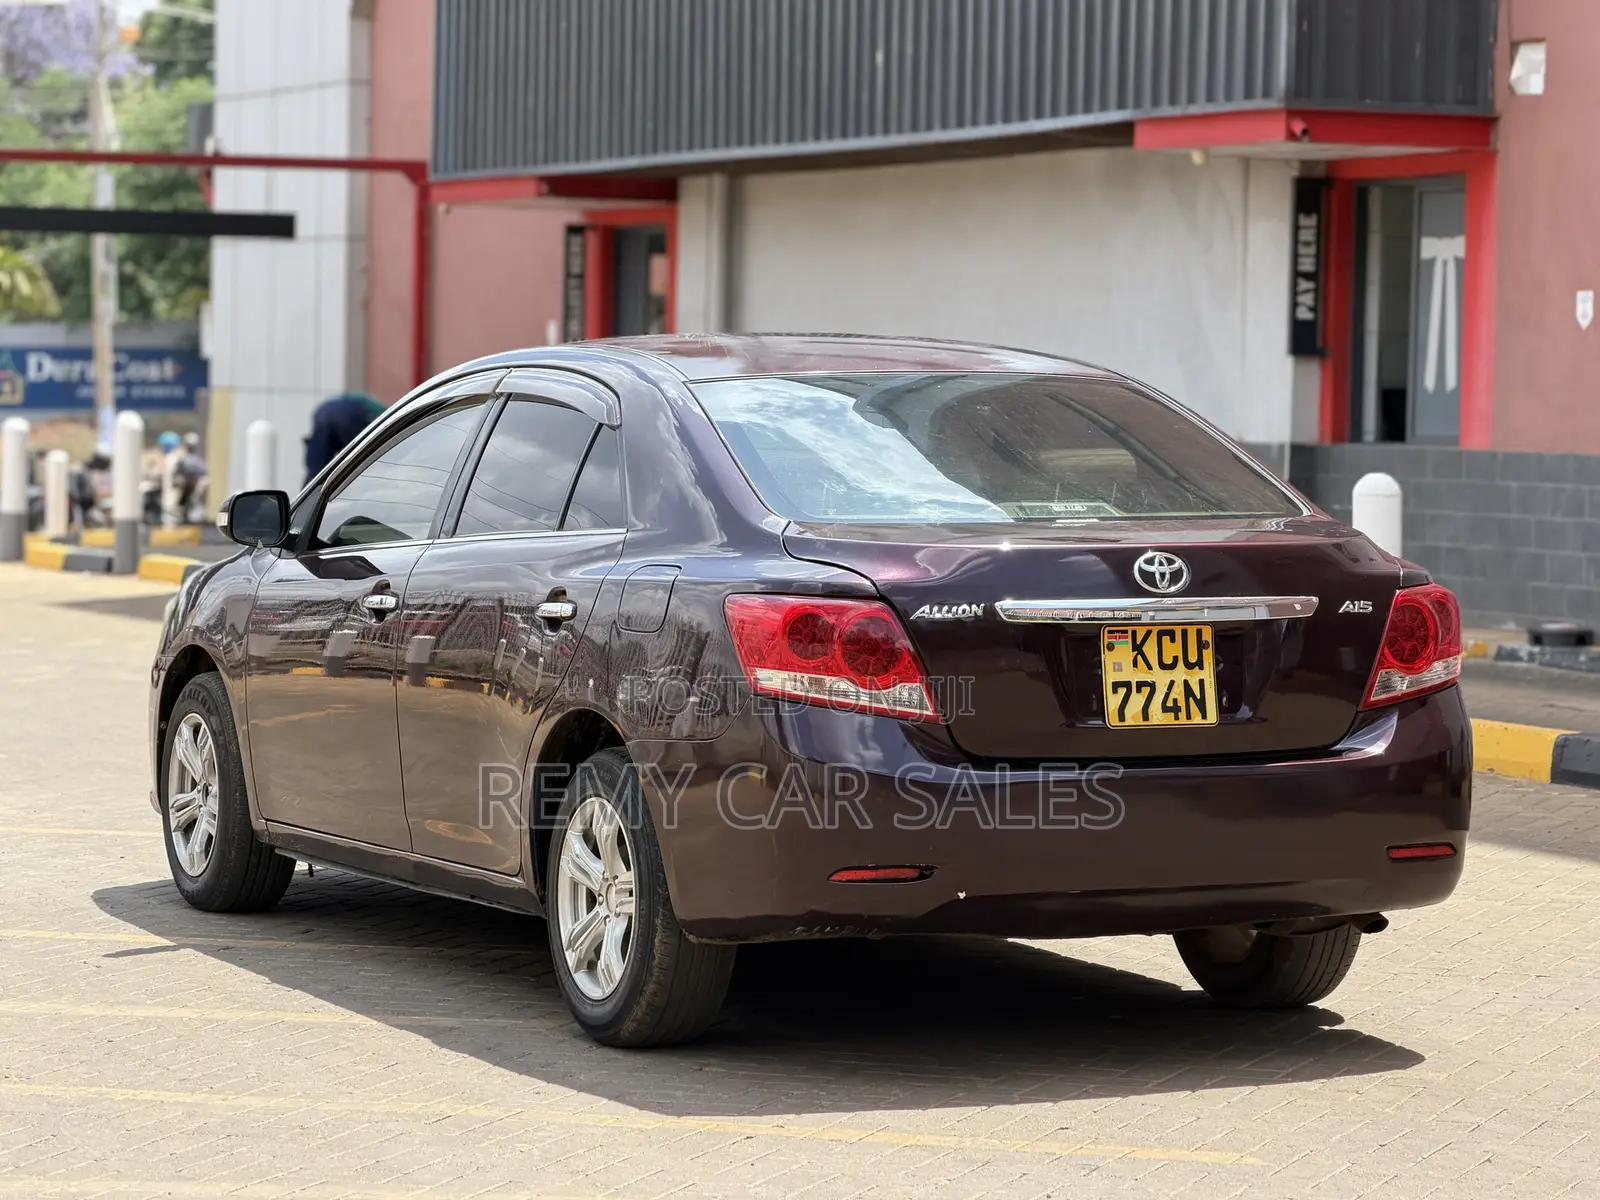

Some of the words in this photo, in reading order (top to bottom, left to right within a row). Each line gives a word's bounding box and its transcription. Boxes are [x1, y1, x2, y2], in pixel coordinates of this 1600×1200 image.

[1296, 212, 1319, 273] HERE
[1295, 277, 1317, 321] PAY
[909, 603, 985, 619] ALLION
[1338, 600, 1373, 614] A15
[1131, 628, 1205, 671] KCU
[1111, 678, 1208, 722] 774N
